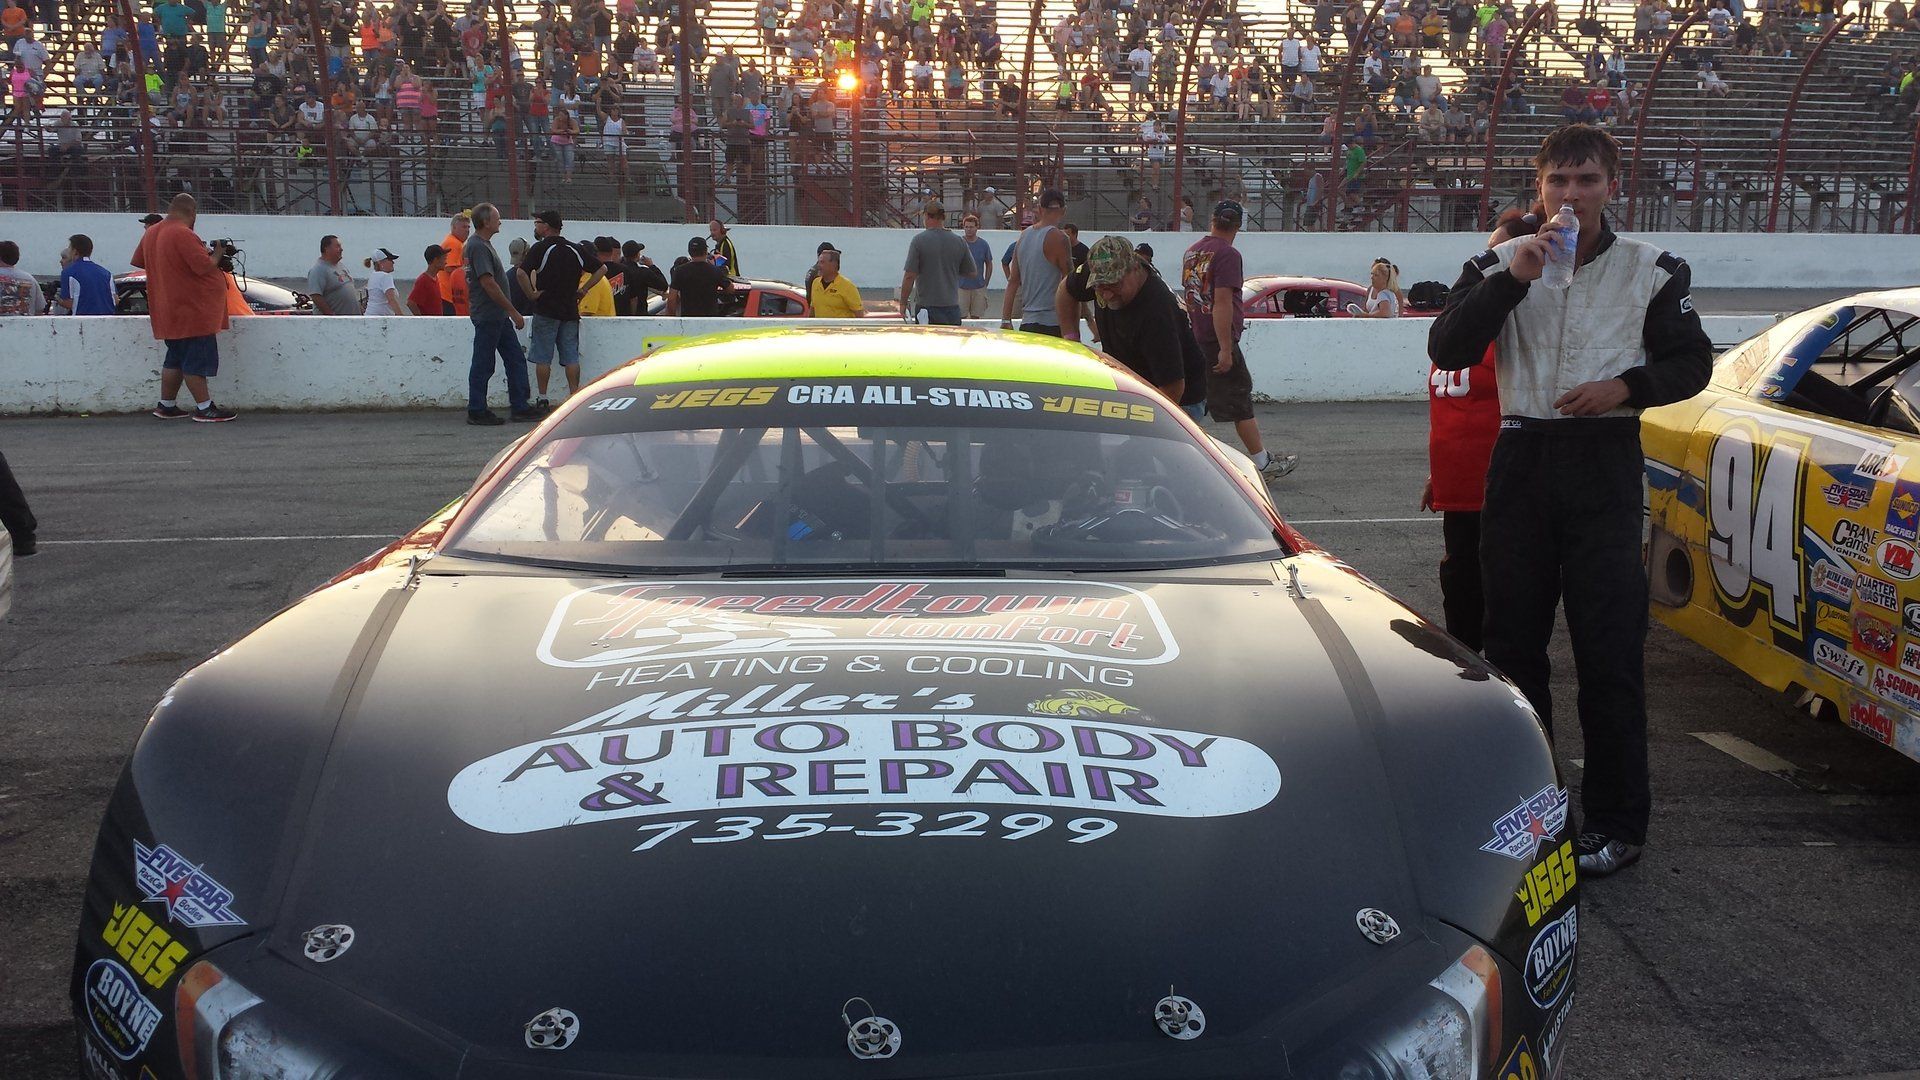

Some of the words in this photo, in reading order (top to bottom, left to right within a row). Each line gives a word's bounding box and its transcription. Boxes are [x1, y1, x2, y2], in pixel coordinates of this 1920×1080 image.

[650, 387, 780, 410] JEGS
[787, 385, 855, 404] CRA
[861, 385, 1034, 410] ALL-STARS
[1431, 367, 1470, 397] 40
[588, 397, 637, 411] 40
[1041, 396, 1155, 422] JEGS
[1829, 484, 1847, 495] FIVE
[1848, 487, 1868, 500] STAR
[1706, 425, 1807, 630] 94
[1899, 529, 1916, 540] FUELS
[1832, 546, 1871, 565] IGNITION
[1856, 573, 1895, 597] QUARTER
[573, 584, 1129, 640] Speedtown
[585, 655, 829, 691] HEATING
[845, 656, 885, 674] &
[906, 656, 1134, 687] COOLING
[551, 683, 976, 735] Miller's
[501, 721, 850, 783] AUTO
[892, 720, 1218, 768] BODY
[579, 772, 672, 812] &
[716, 758, 1166, 807] REPAIR
[632, 812, 1119, 852] 735-3299
[1498, 808, 1530, 839] FIVE
[1529, 785, 1560, 818] STAR
[148, 850, 191, 882] FIVE
[188, 874, 230, 913] STAR
[1522, 840, 1577, 927] JEGS
[178, 898, 204, 921] Bodies
[102, 904, 189, 989] JEGS
[1532, 911, 1577, 980] BOYNE
[97, 965, 159, 1042] BOYNE
